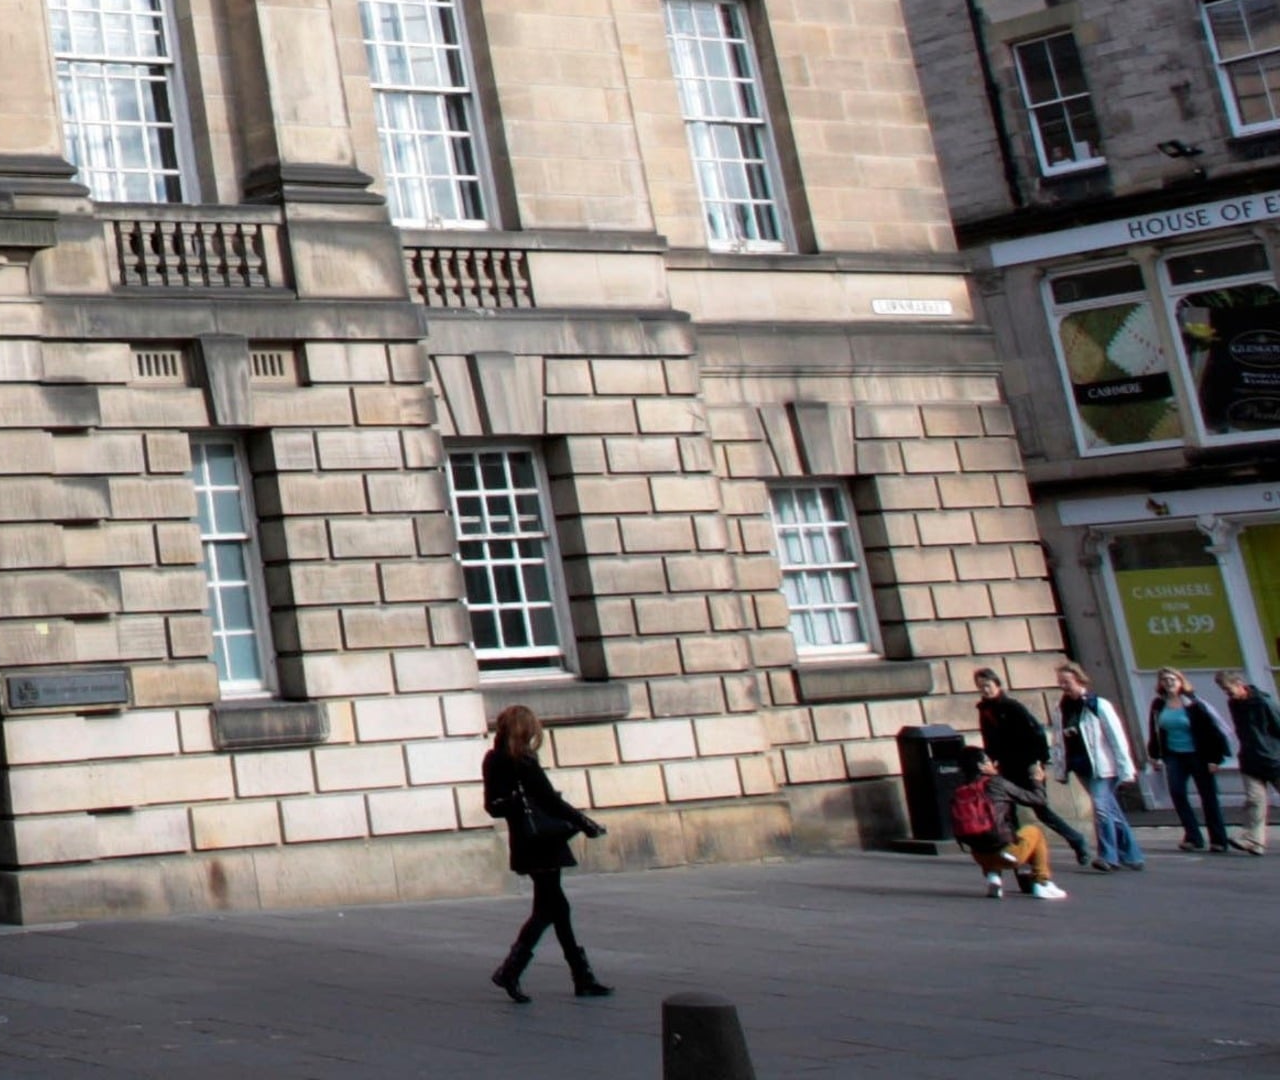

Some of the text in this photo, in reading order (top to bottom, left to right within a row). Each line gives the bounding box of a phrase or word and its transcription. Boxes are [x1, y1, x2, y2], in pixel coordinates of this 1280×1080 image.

[1127, 194, 1280, 239] HOUSE OF E
[1132, 583, 1214, 599] CASHMERE
[1147, 614, 1215, 635] £14.99
